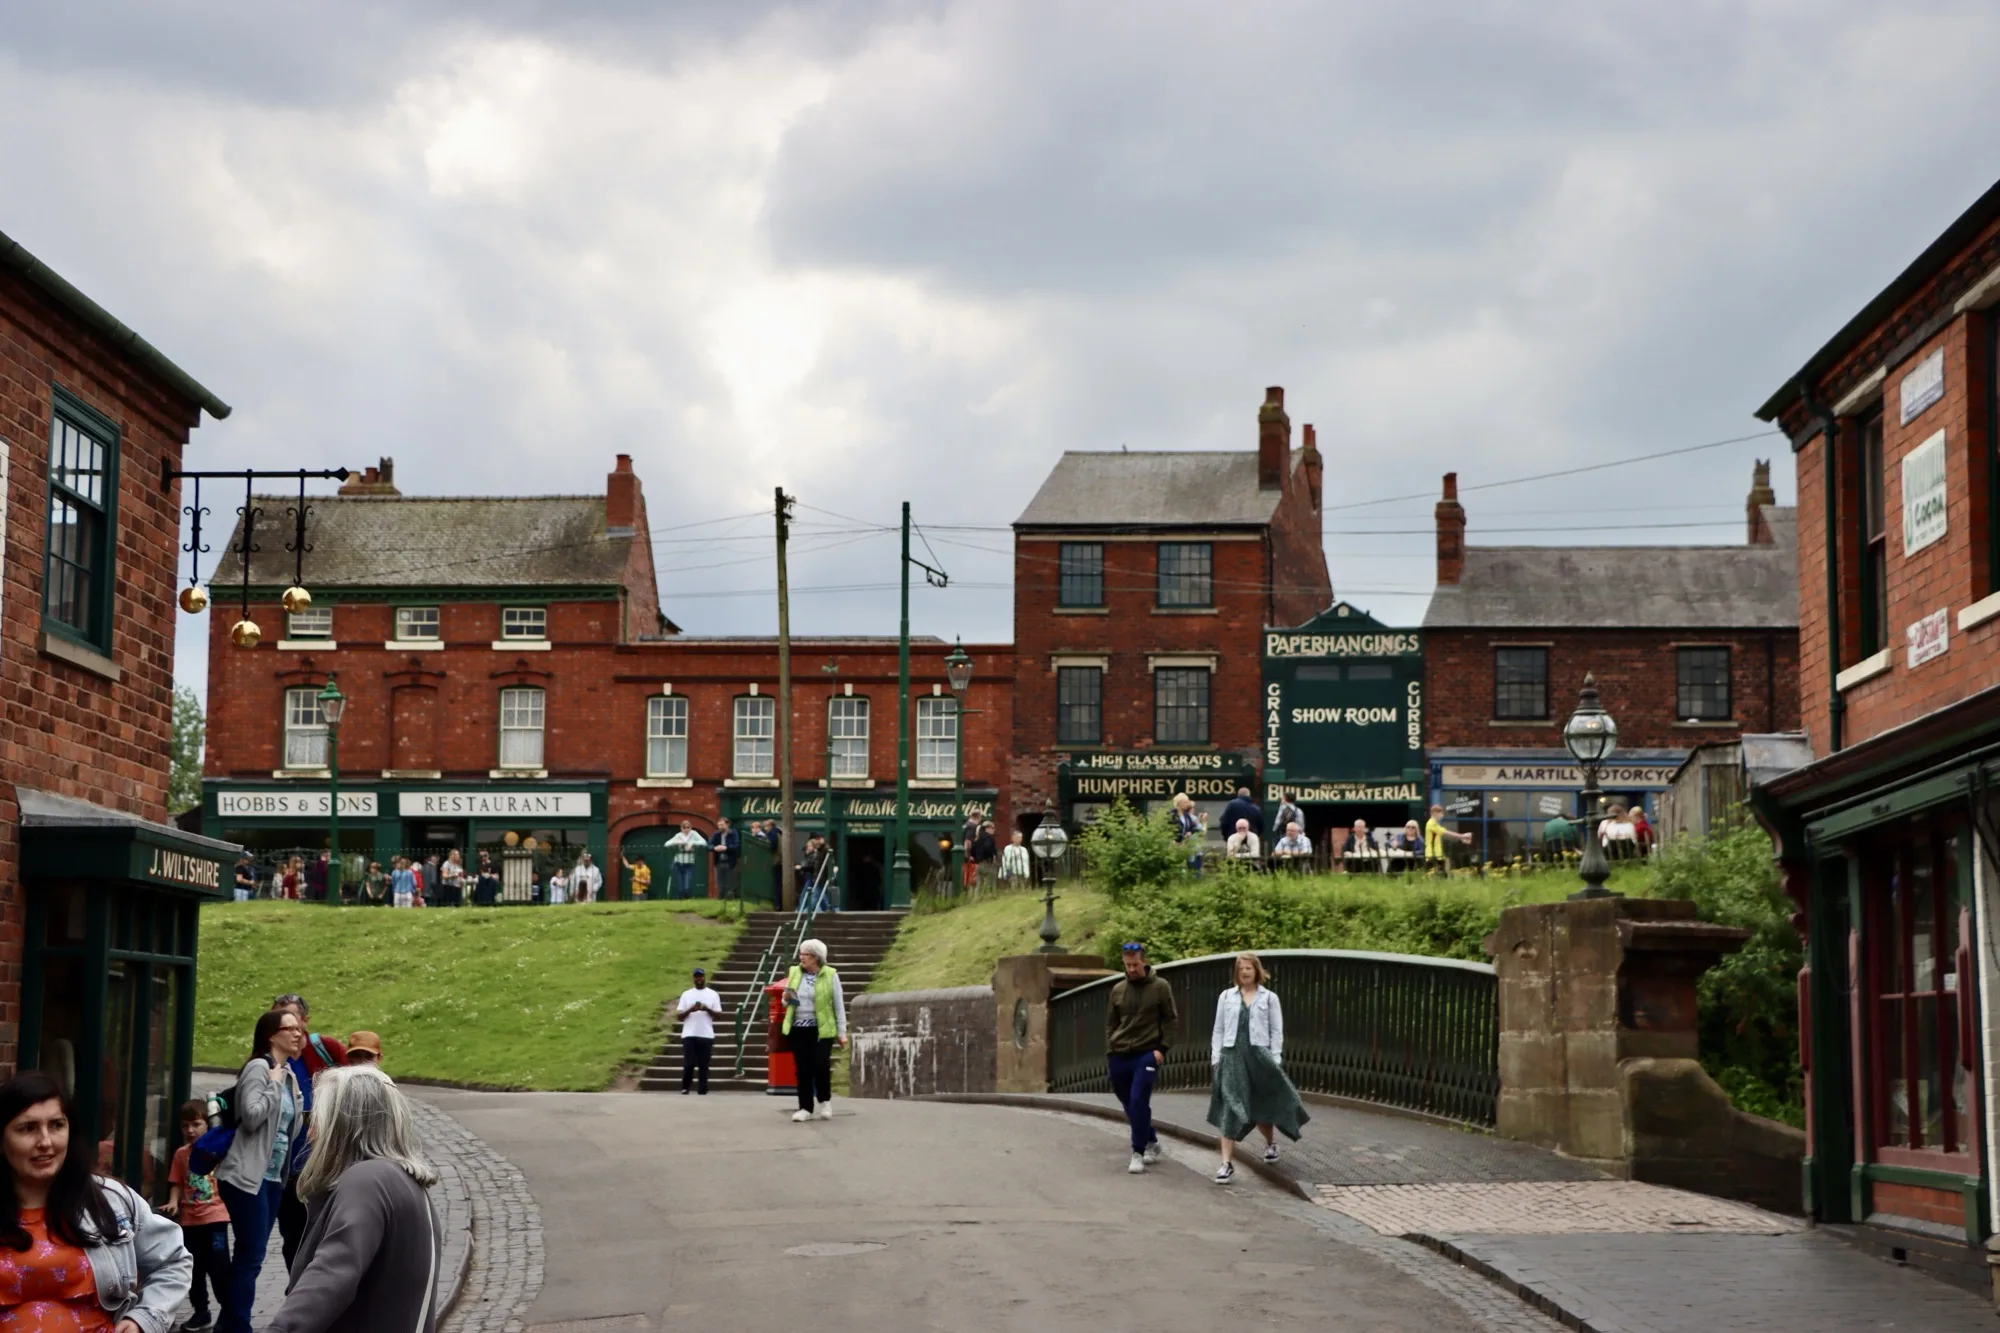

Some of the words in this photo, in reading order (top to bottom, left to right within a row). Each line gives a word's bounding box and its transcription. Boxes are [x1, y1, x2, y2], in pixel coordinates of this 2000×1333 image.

[1267, 634, 1419, 656] PAPERHANGINGS
[1267, 683, 1280, 765] GRATES
[1292, 708, 1341, 723] SHOW
[1344, 707, 1397, 726] ROOM
[1407, 681, 1420, 750] CURBS
[1091, 754, 1123, 768] HIGH
[1126, 755, 1167, 765] CLASS
[1170, 754, 1222, 768] GRATES
[1077, 779, 1178, 794] HUMPHREY
[1345, 783, 1422, 801] MATERIAL
[223, 797, 288, 812] HOBBS
[298, 799, 308, 812] &
[319, 797, 372, 812] SONS
[424, 797, 563, 812] RESTAURANT
